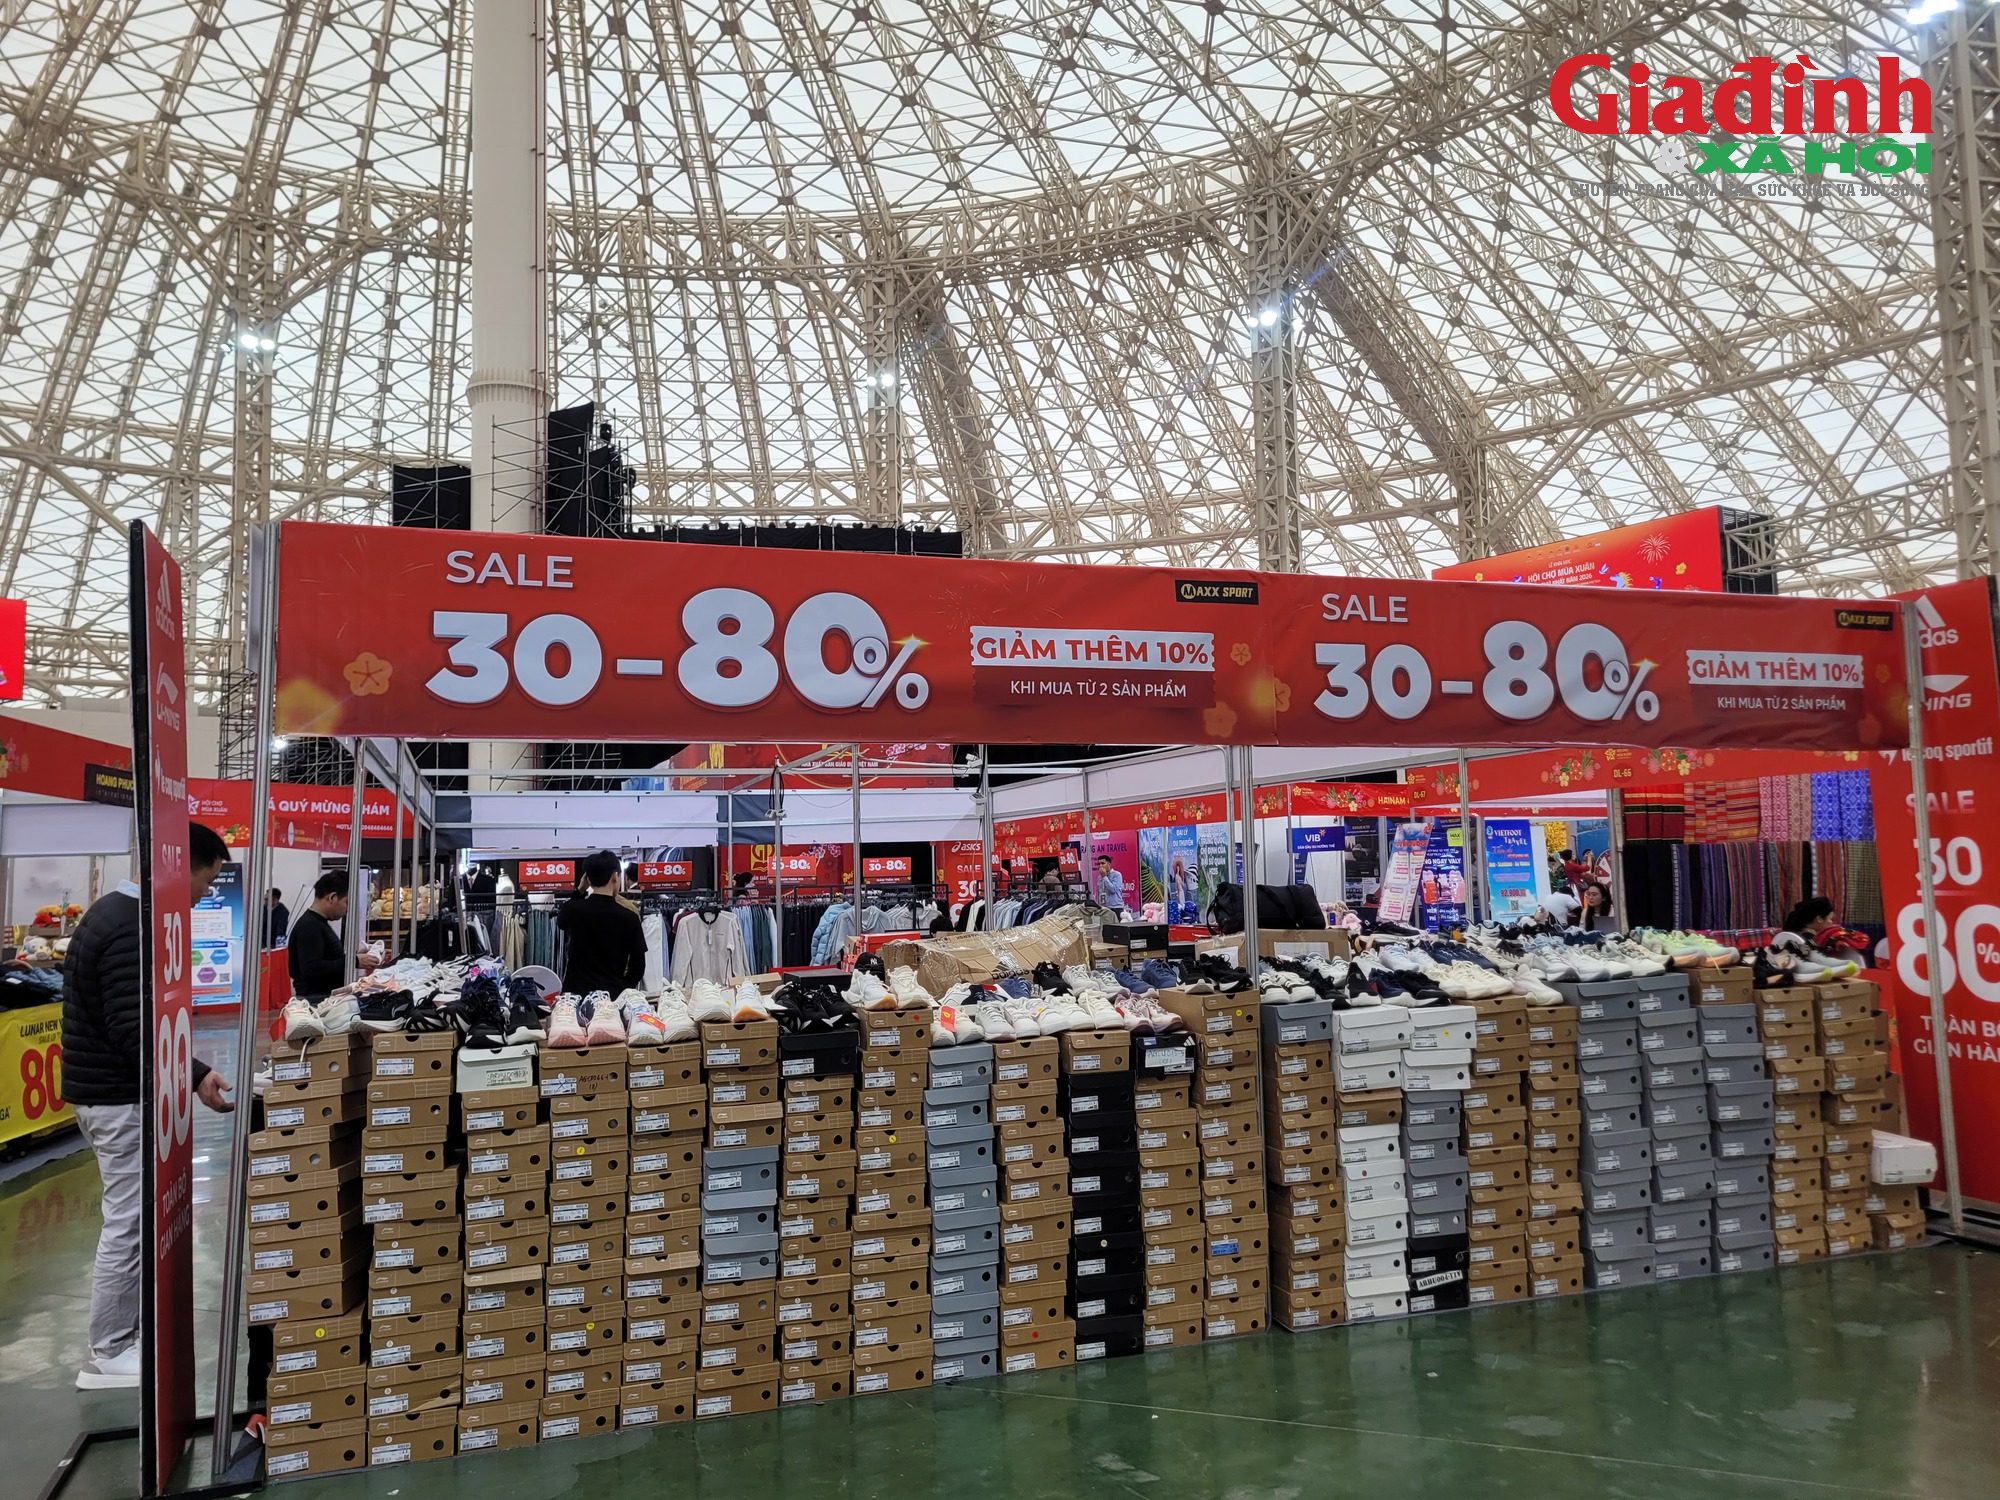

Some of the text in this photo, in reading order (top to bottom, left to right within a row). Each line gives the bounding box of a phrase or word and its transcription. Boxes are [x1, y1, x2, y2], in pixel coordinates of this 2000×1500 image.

[446, 550, 574, 589] SALE
[1527, 562, 1595, 583] HỘI CHỢ MÙA XUÂN
[1222, 587, 1253, 598] SPORT
[1321, 593, 1408, 623] SALE
[977, 631, 1208, 665] GIẢM THÊM 10%
[1919, 628, 1959, 648] das
[1692, 653, 1859, 682] GIẢM THÊM 10%
[1010, 679, 1187, 698] KHI MUA TỪ 2 SẢN PHẨM
[1717, 694, 1846, 710] KHI MUA TỪ 2 SẢN PHẨM
[1945, 737, 1993, 760] sportif
[279, 798, 390, 815] QUÝ MỪNG HÁM
[1378, 797, 1405, 805] HAINAM
[1906, 790, 1975, 815] SALE
[1097, 843, 1128, 852] AN TRAVEL
[1305, 834, 1321, 842] VIB
[161, 842, 181, 878] SALE
[957, 864, 981, 873] SALE
[163, 911, 182, 985] 30
[20, 1020, 58, 1037] LUNAR NEW
[1920, 1014, 1976, 1036] TÀN
[1913, 1038, 1962, 1058] GIN
